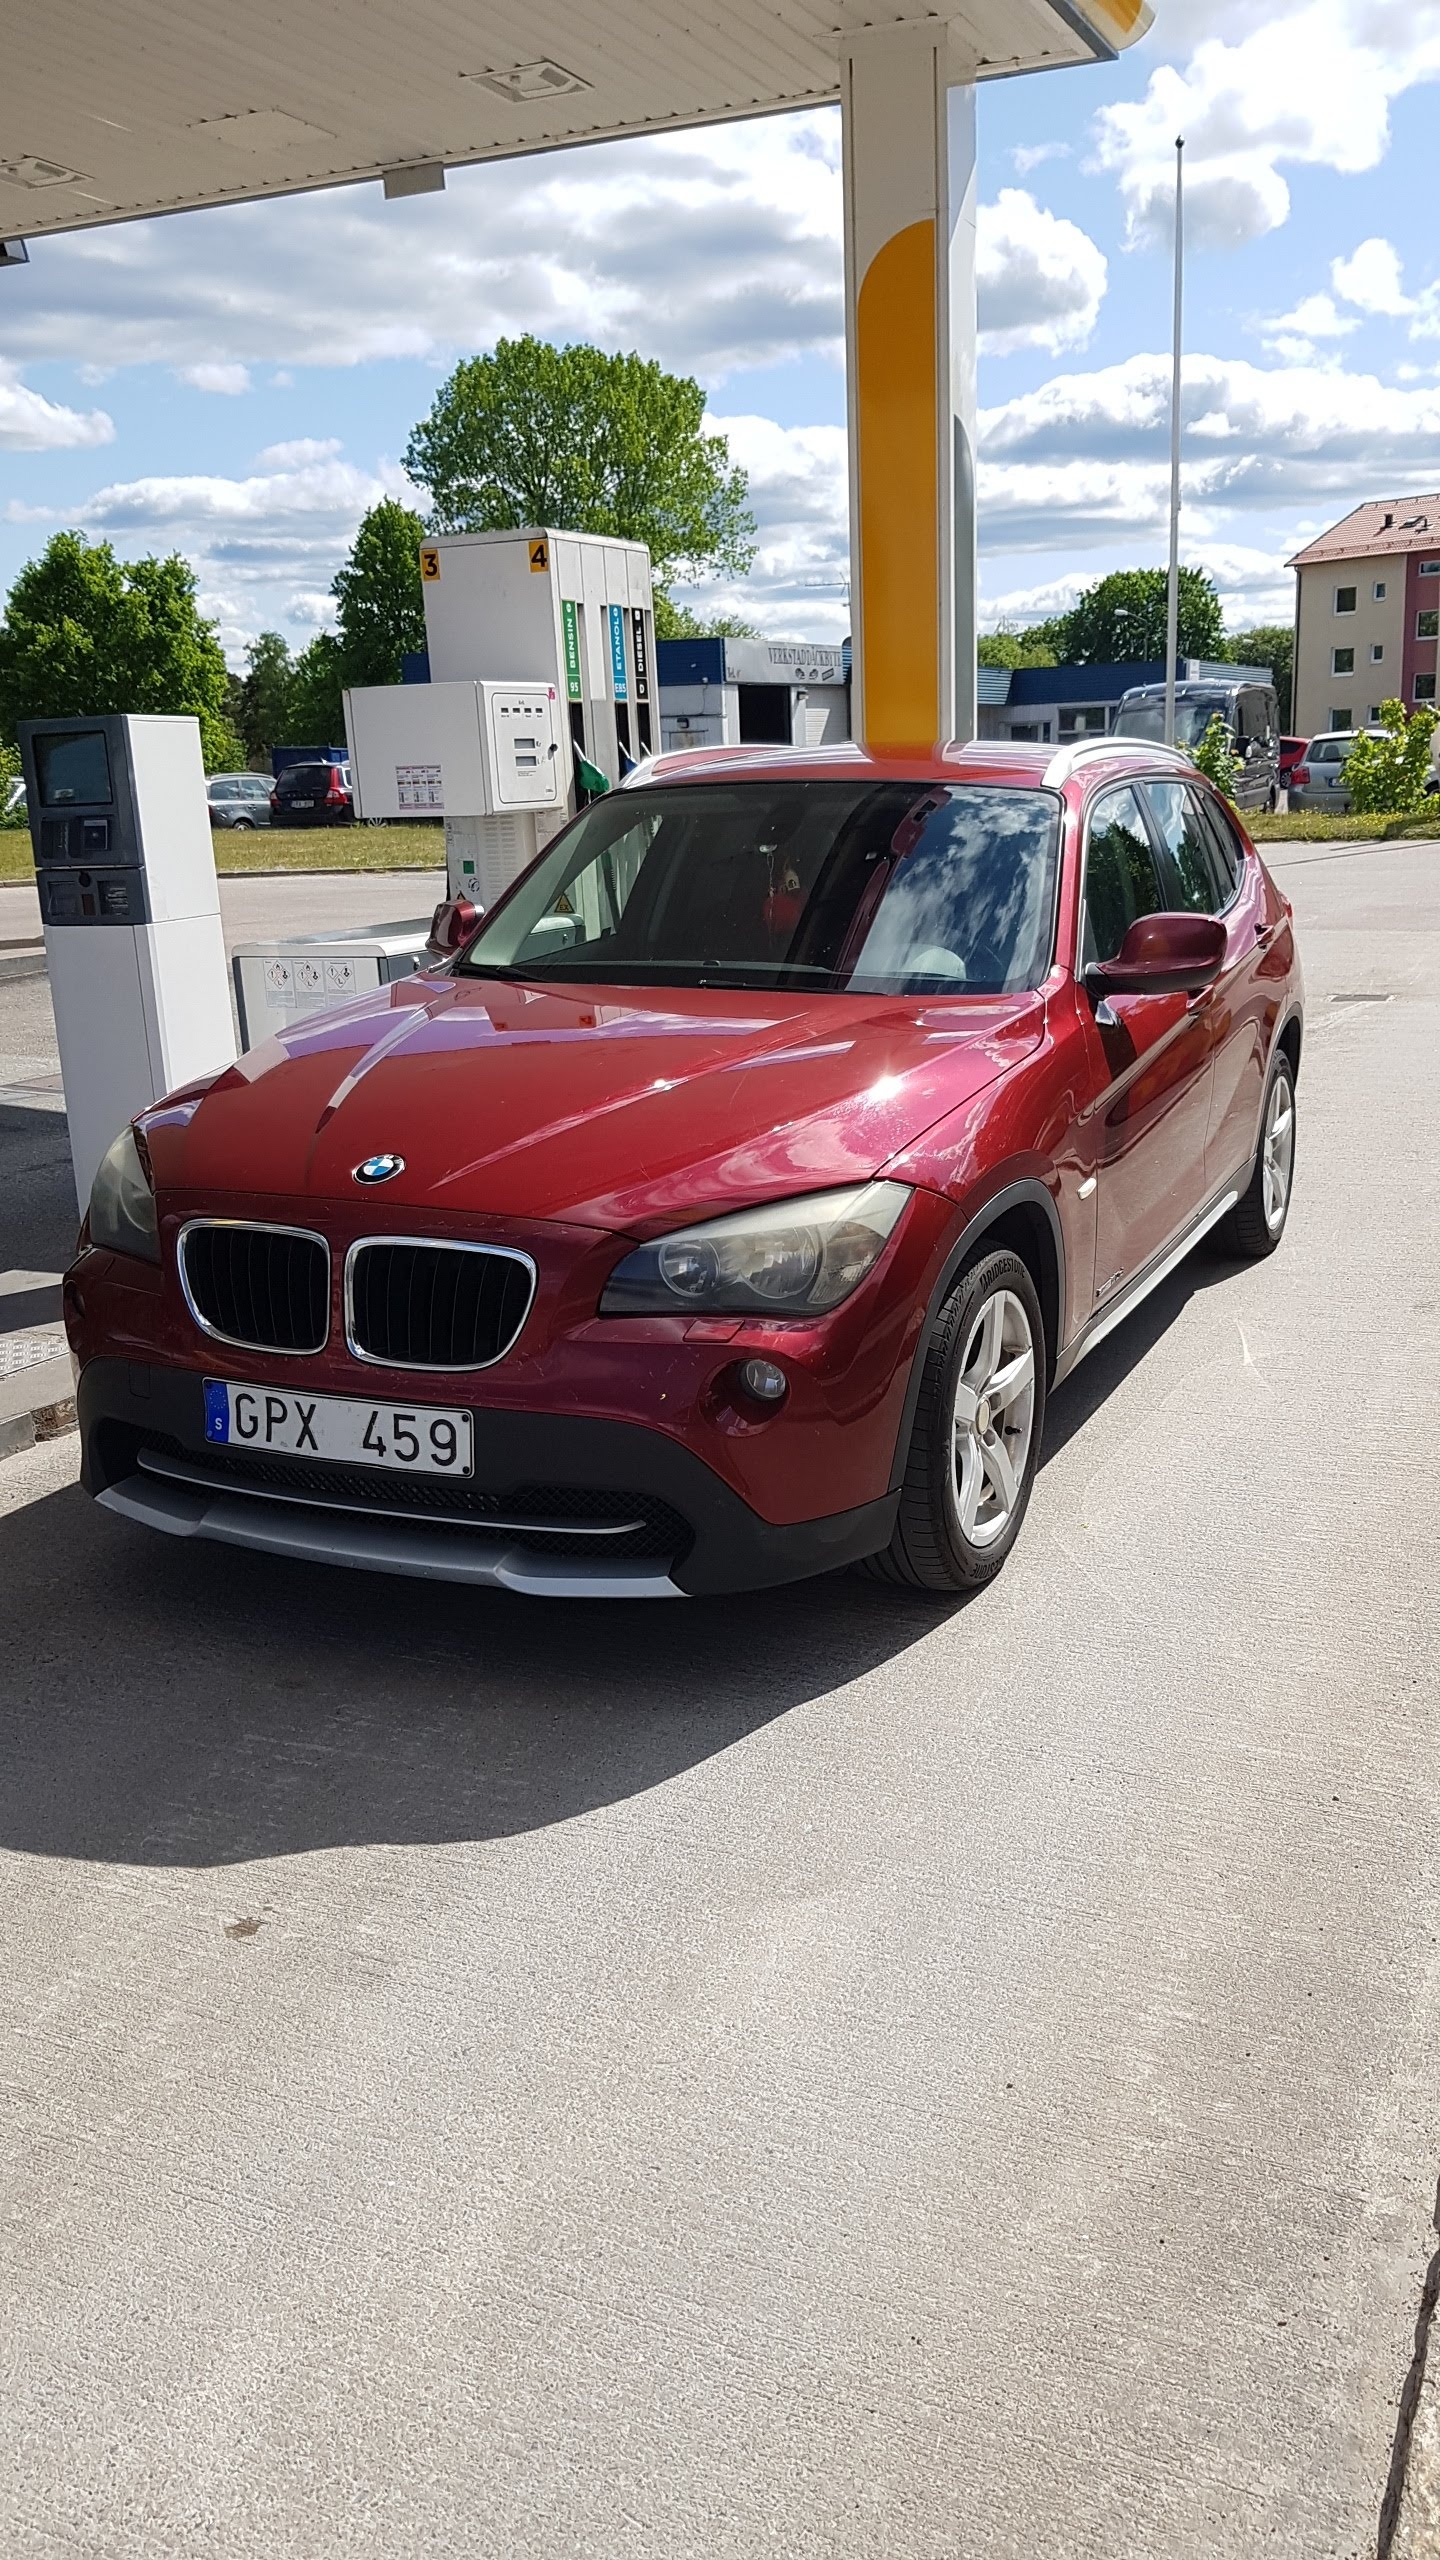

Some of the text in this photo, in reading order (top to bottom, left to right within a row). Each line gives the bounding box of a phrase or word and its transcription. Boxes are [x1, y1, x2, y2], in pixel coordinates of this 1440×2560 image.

[423, 554, 438, 576] 3
[531, 544, 548, 568] 4
[567, 618, 576, 668] BENSIN
[614, 617, 622, 670] ETANOL
[636, 626, 644, 672] DIESEL
[570, 682, 579, 692] 95
[615, 683, 626, 693] E85
[639, 684, 645, 694] D
[979, 1257, 1026, 1295] BRIDGESTONE
[214, 1418, 223, 1431] S
[235, 1393, 457, 1467] GPX 459
